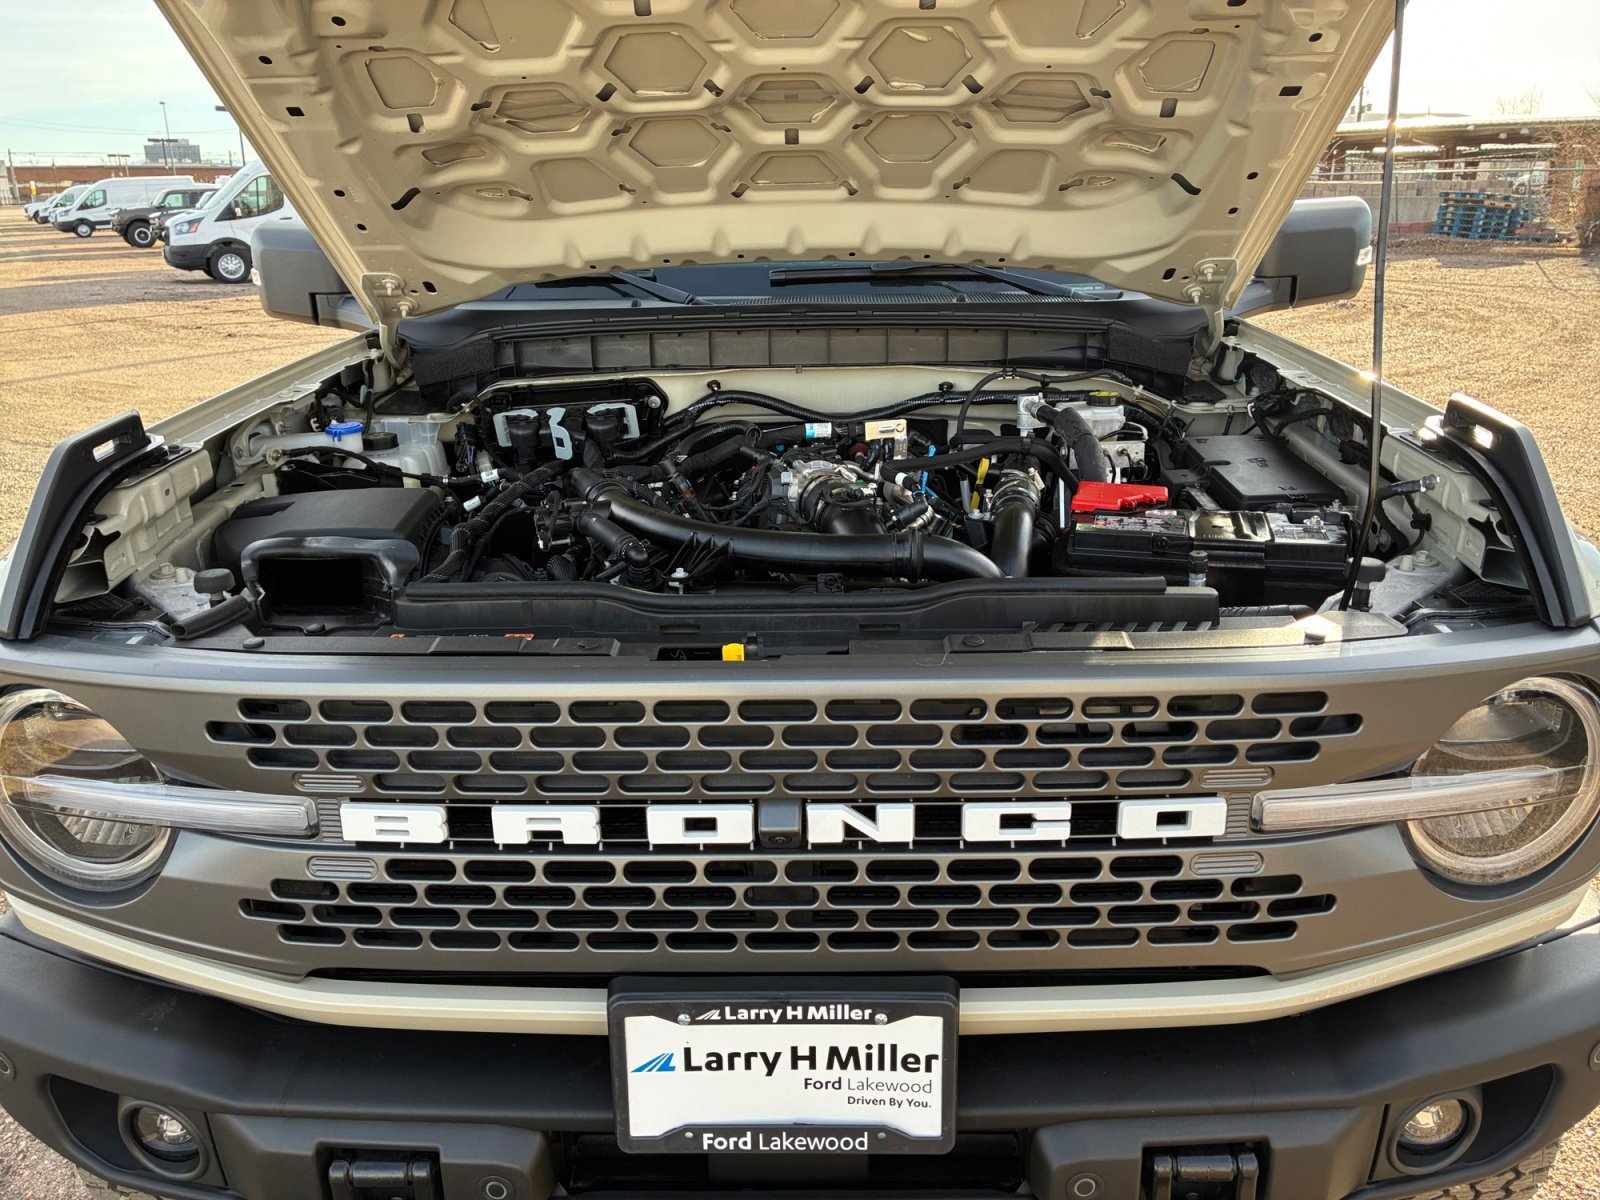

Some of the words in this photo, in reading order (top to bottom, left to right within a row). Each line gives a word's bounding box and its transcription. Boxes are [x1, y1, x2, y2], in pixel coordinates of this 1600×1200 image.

[340, 798, 1227, 847] BRONCO
[724, 1005, 783, 1024] Larry
[786, 1005, 803, 1020] H
[806, 1003, 873, 1021] Miller
[683, 1046, 783, 1077] Larry
[790, 1045, 817, 1071] H
[825, 1043, 940, 1073] Miller
[804, 1076, 842, 1091] Ford
[847, 1077, 932, 1094] Lakewood
[847, 1096, 886, 1106] Driven
[889, 1097, 904, 1109] By
[906, 1098, 932, 1108] You.
[702, 1131, 752, 1151] Ford
[758, 1131, 869, 1151] Lakewood
